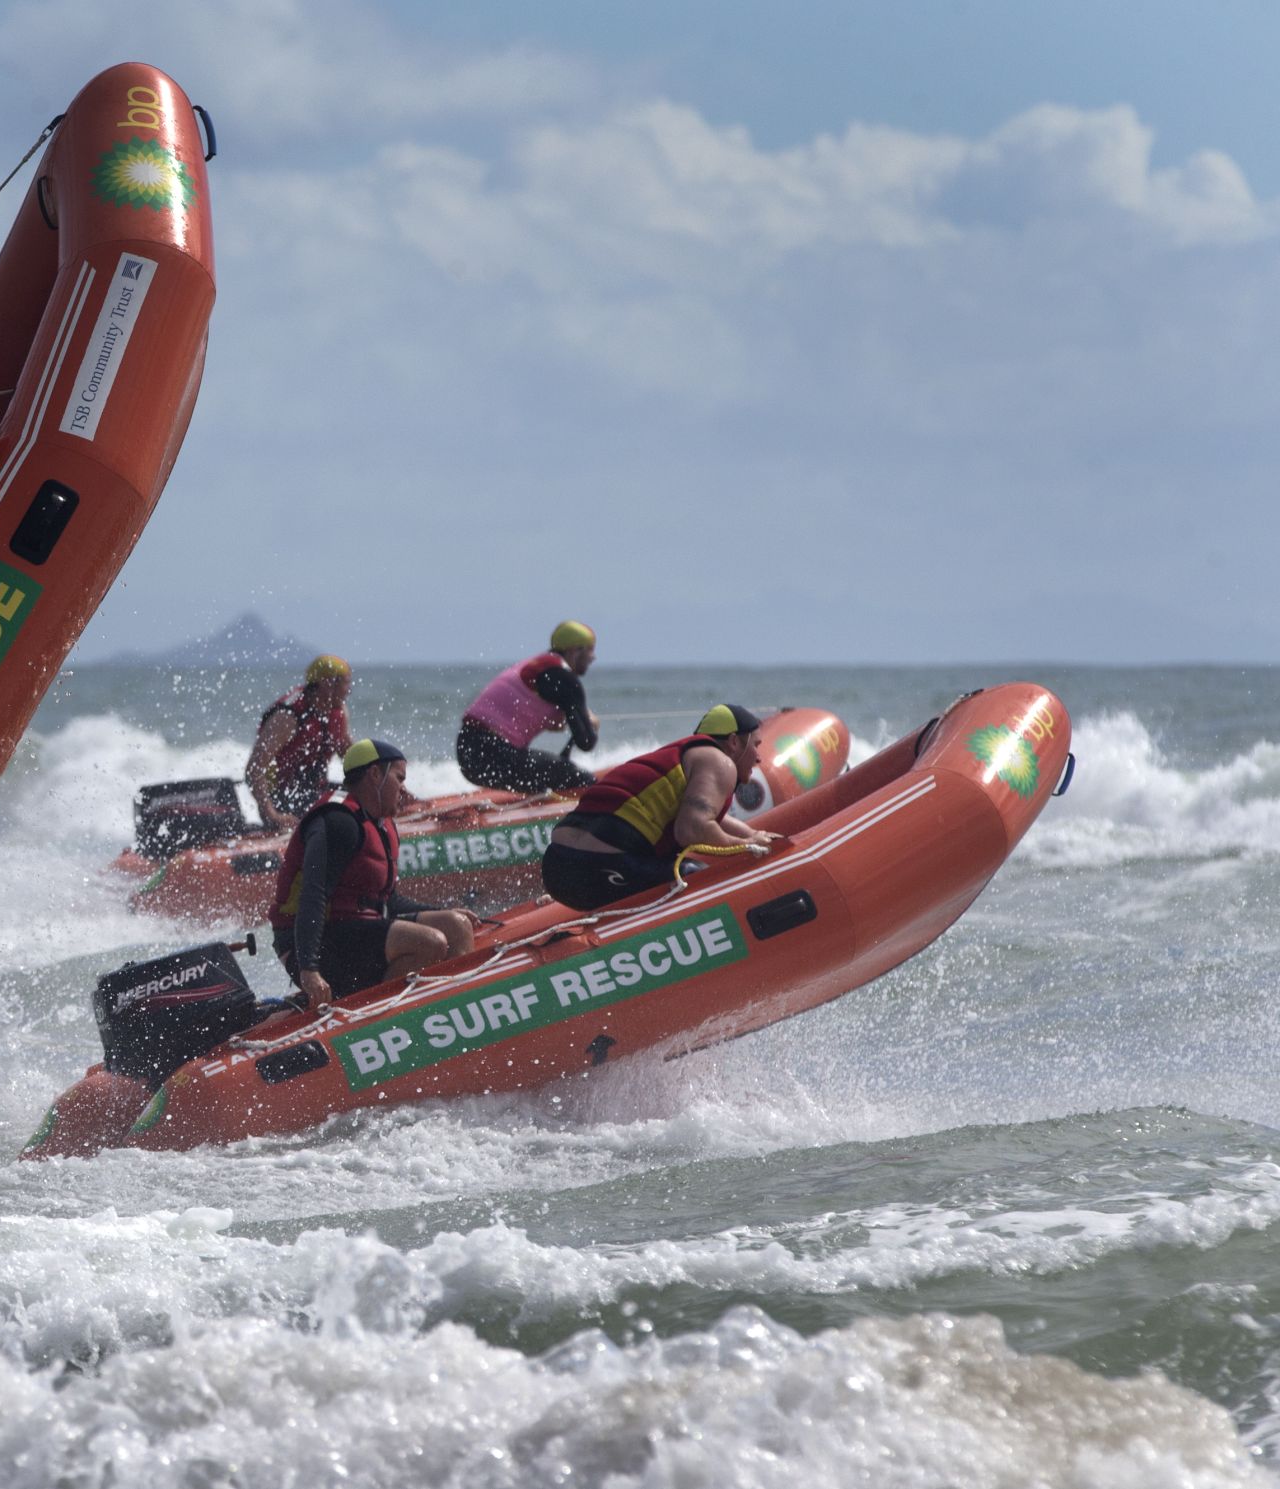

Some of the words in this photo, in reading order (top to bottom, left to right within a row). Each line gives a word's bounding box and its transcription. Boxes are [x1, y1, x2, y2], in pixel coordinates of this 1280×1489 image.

[117, 86, 160, 130] bp
[70, 404, 91, 432] TSB
[81, 323, 124, 404] Community
[110, 286, 135, 319] Trust
[112, 963, 208, 1014] MERCURY
[348, 1028, 415, 1076] BP
[426, 985, 540, 1050] SURF
[549, 917, 734, 1007] RESCUE
